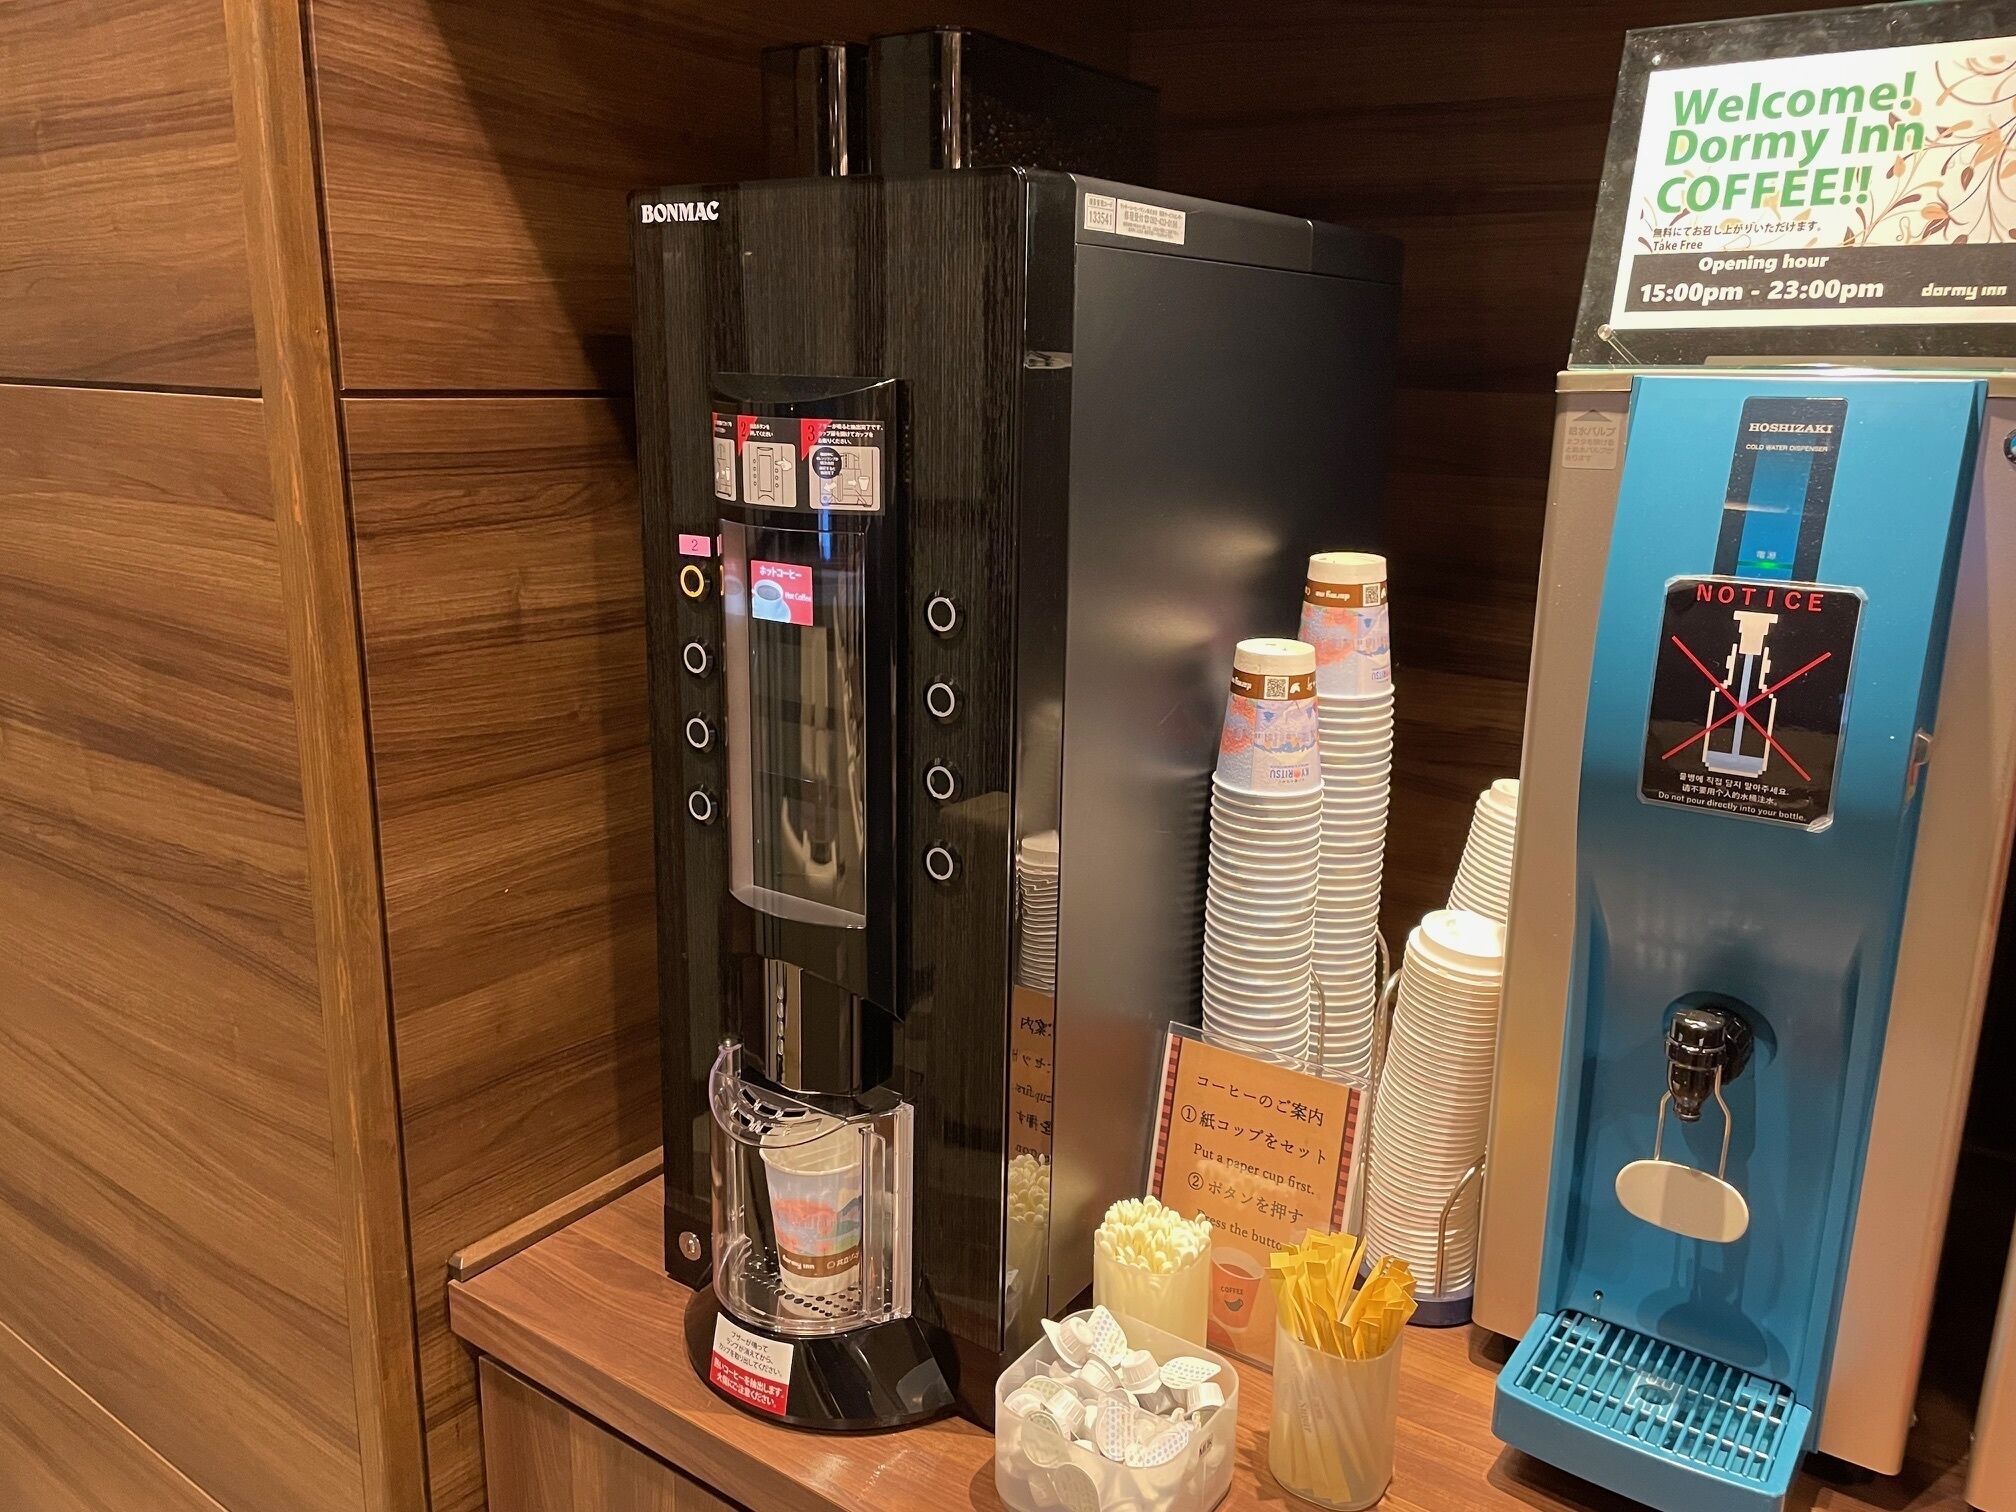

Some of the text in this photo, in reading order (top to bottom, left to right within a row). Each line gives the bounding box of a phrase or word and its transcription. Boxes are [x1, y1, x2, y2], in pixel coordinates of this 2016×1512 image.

[1674, 71, 1916, 126] Welcome!
[1665, 117, 1924, 168] Dormy Inn
[1657, 166, 1872, 213] COFFEE!!
[641, 201, 720, 224] BONMAC
[1089, 210, 1112, 226] 133541
[1653, 221, 1821, 238] 無料にてお召し上がりいただけます。
[1653, 239, 1703, 251] Take Free
[1698, 254, 1829, 275] Opening hour
[1640, 282, 1744, 306] 15:00pm
[1767, 279, 1884, 303] 23:00pm
[1921, 282, 2007, 301] dormy inn
[741, 421, 746, 437] 2
[807, 424, 816, 442] 3
[1748, 422, 1834, 434] HOSHIZAKI
[1745, 443, 1764, 451] COLD
[691, 539, 698, 551] 2
[760, 565, 802, 579] ホットコーヒー
[1696, 583, 1824, 612] NOTICE
[1658, 791, 1807, 822] Do not pour directly into your bottle.
[1197, 1075, 1324, 1127] コーヒーのご案内
[1193, 1142, 1315, 1195] Put a paper cup first.
[1229, 1222, 1249, 1238] the
[1251, 1229, 1282, 1251] butto
[1220, 1285, 1244, 1295] COFFEE
